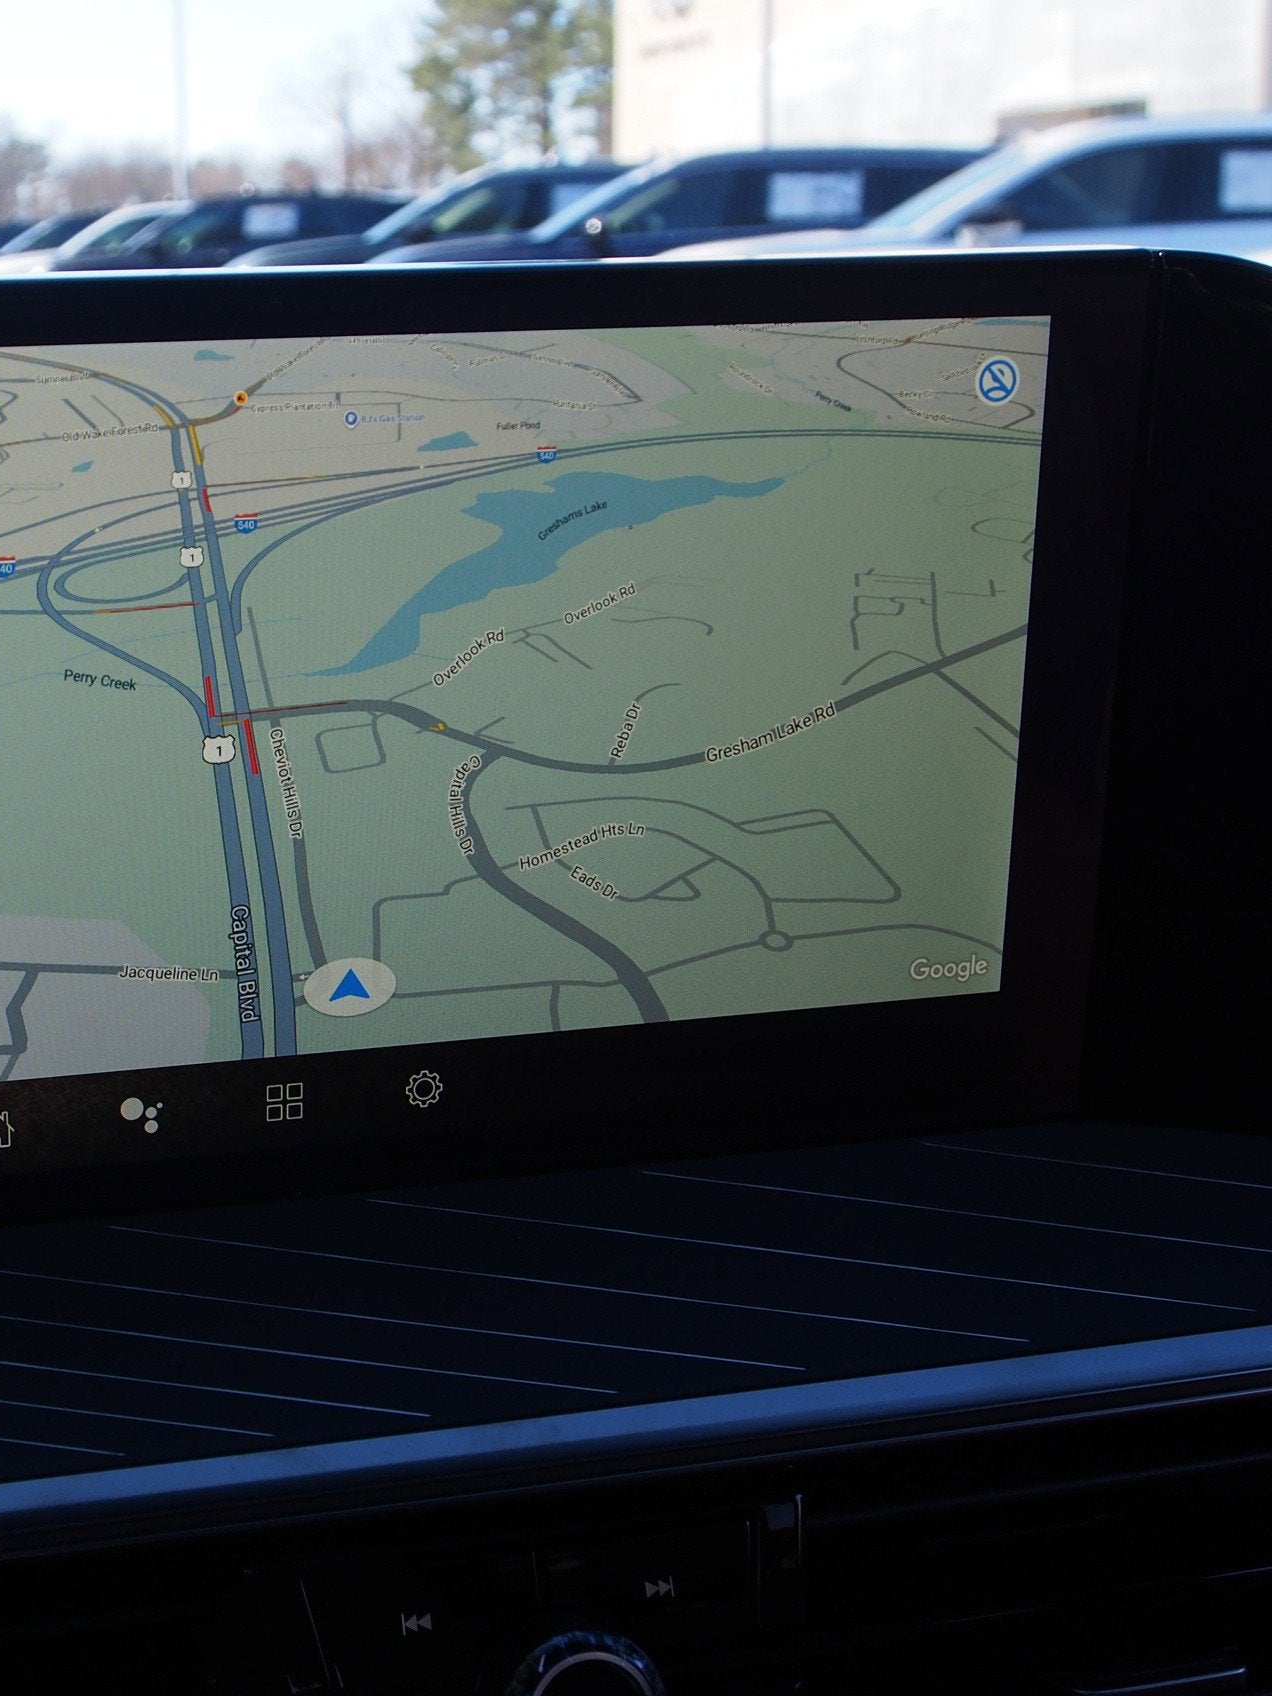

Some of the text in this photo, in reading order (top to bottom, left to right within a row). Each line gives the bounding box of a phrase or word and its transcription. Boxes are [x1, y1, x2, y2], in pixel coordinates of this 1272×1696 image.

[539, 451, 555, 460] 540
[238, 521, 255, 529] 540
[538, 501, 608, 540] Greshams Lake
[564, 583, 636, 624] Overlook Rd
[433, 629, 505, 686] Overlook Rd
[63, 669, 137, 691] Perry Creek
[610, 703, 641, 758] Reba Dr
[706, 702, 835, 762] Gresham Lake Rd
[215, 746, 223, 757] 1
[269, 729, 303, 839] Cheviot Hills Dr
[449, 754, 481, 855] Capital Hills Dr
[520, 822, 645, 870] Homestead Hts Ln
[570, 865, 619, 900] Eads Dr
[119, 966, 218, 982] Jacqueline Ln
[229, 905, 260, 1023] Capital Blvd
[910, 954, 988, 982] Google
